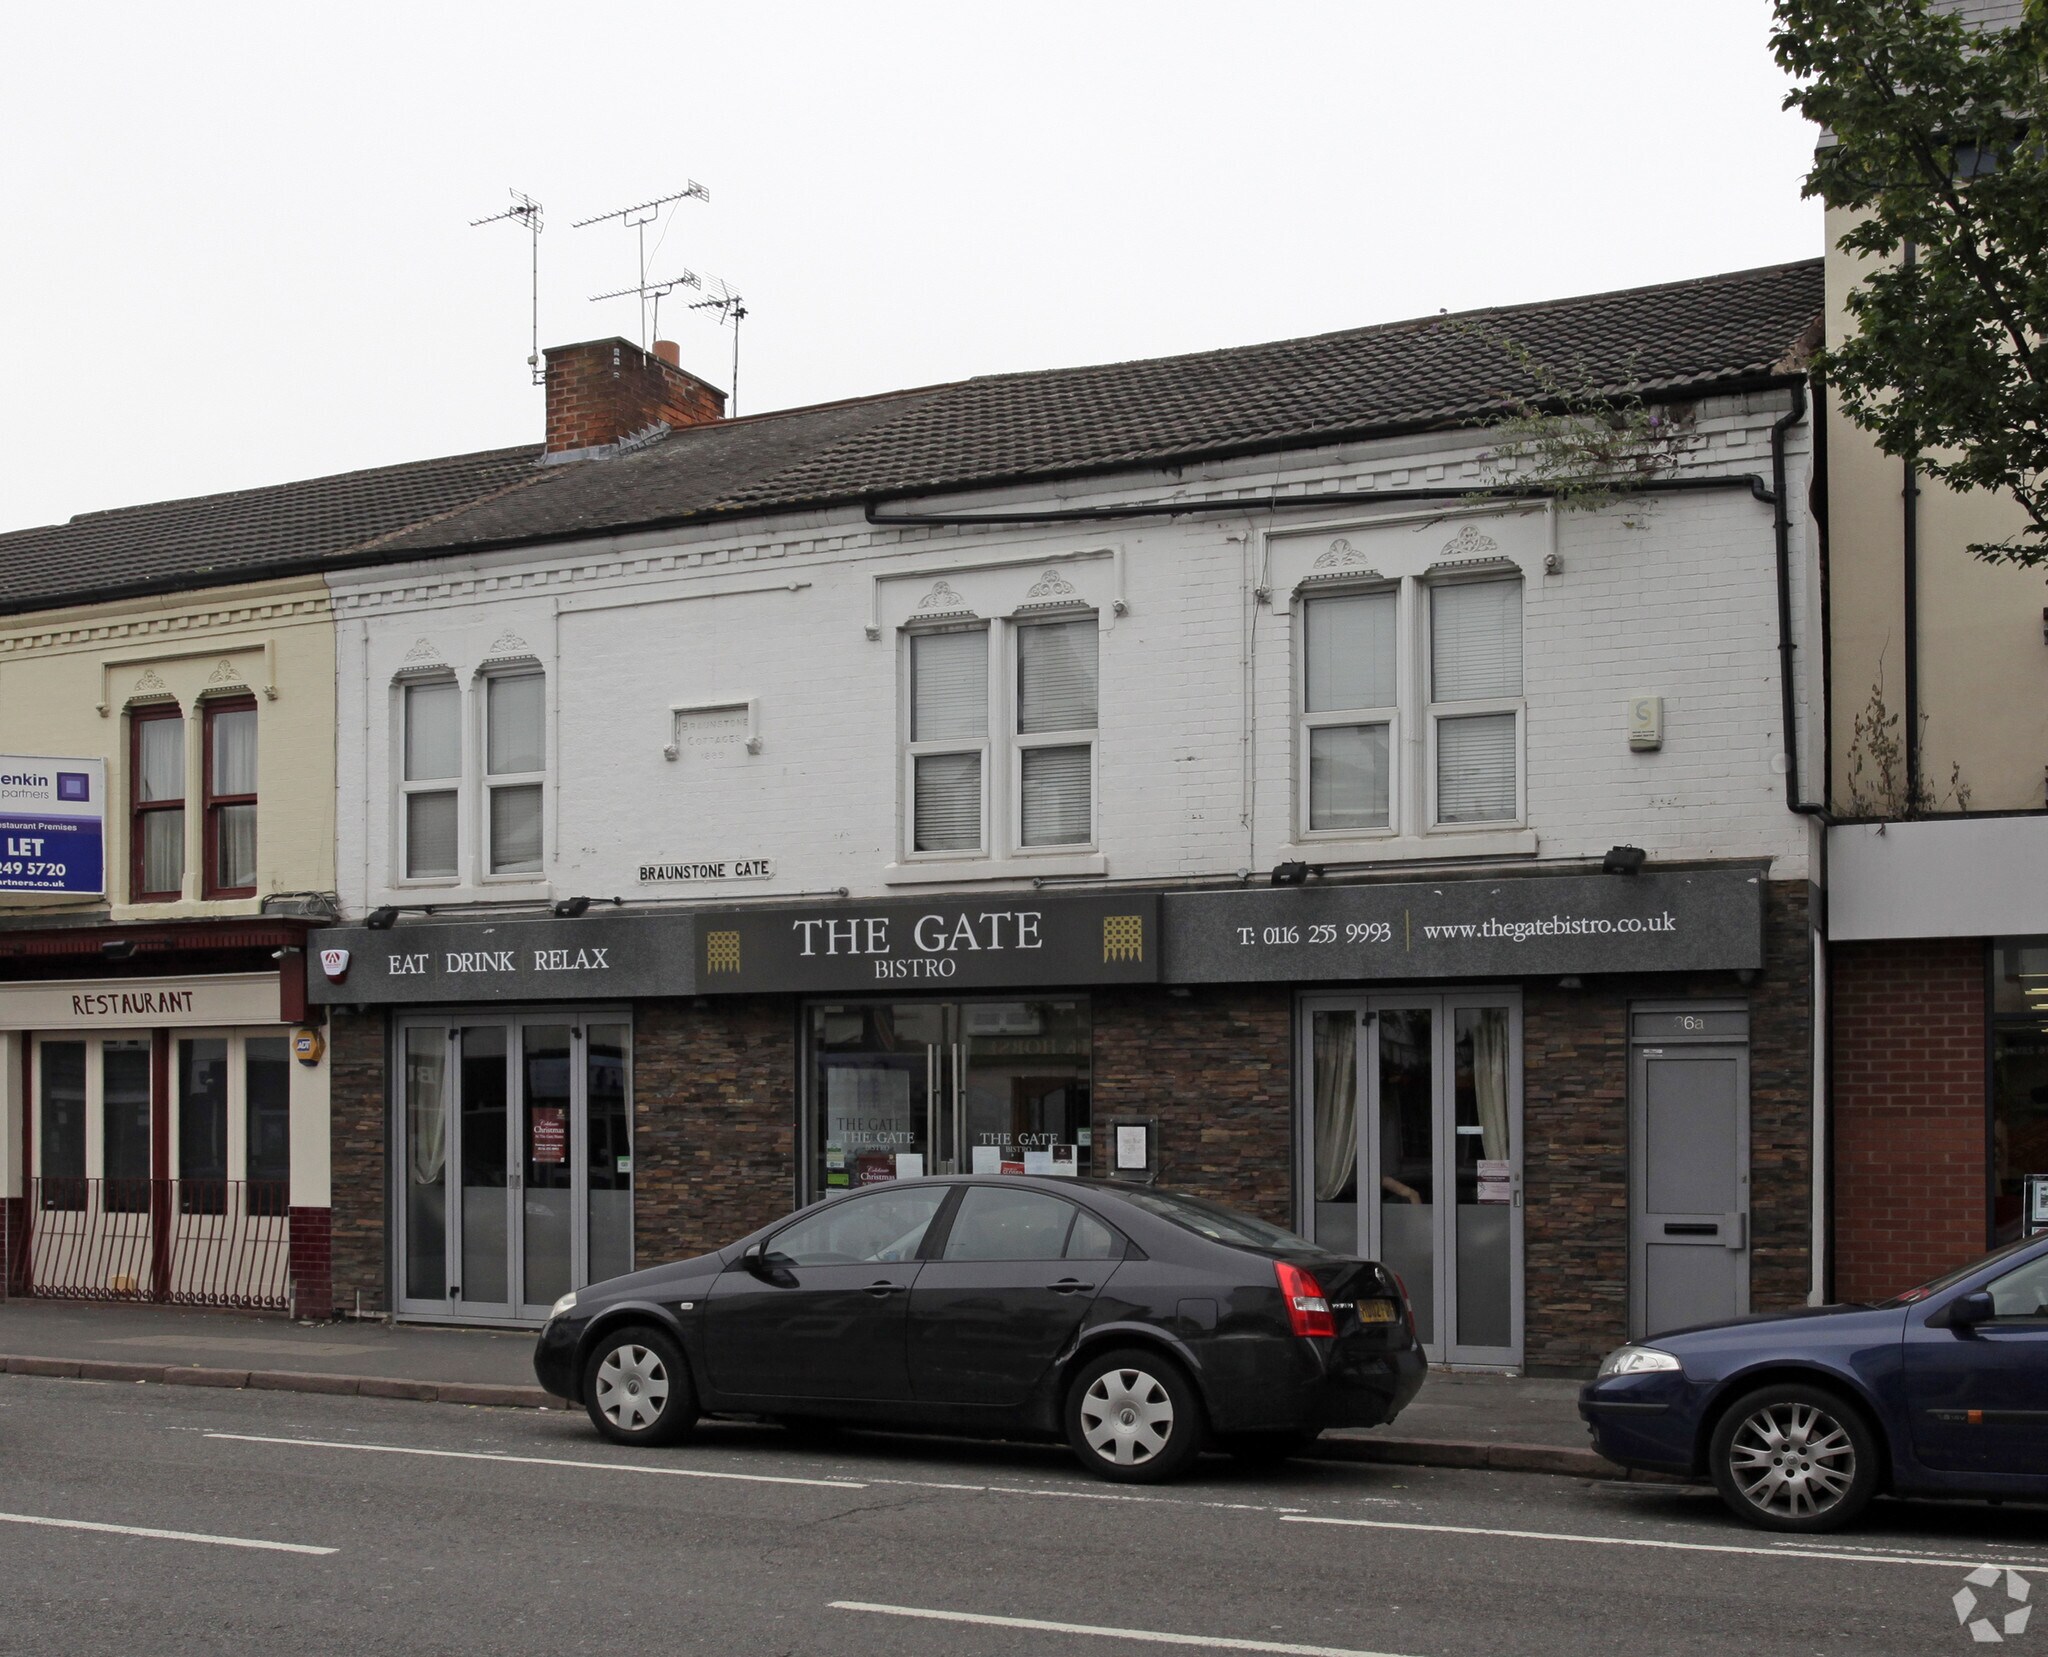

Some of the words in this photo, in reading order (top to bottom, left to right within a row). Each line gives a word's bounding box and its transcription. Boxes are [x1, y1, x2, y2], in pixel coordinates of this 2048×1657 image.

[1, 773, 48, 786] enkin
[2, 789, 49, 799] partners
[0, 822, 36, 830] staurant
[38, 822, 77, 832] Premises
[7, 837, 44, 857] LET
[0, 861, 23, 875] 49
[27, 862, 66, 876] 5720
[640, 863, 725, 881] BRAUNSTONE
[735, 860, 769, 876] GATE
[793, 917, 890, 956] THE
[914, 911, 1043, 952] GATE
[1237, 927, 1255, 945] T:
[1263, 926, 1300, 945] 0116
[1308, 924, 1338, 944] 255
[1346, 922, 1392, 944] 9993
[1424, 911, 1676, 942] www.thegatebistro.co.uk
[388, 953, 429, 975] EAT
[446, 951, 515, 973] DRINK
[534, 948, 610, 971] RELAX
[874, 958, 956, 979] BISTRO
[72, 991, 193, 1015] RESTAURANT
[533, 1125, 565, 1134] Christmas
[841, 1131, 871, 1144] THE
[876, 1131, 915, 1144] GATE
[980, 1132, 1012, 1145] THE
[1018, 1133, 1059, 1146] GATE
[860, 1172, 895, 1181] Christmas
